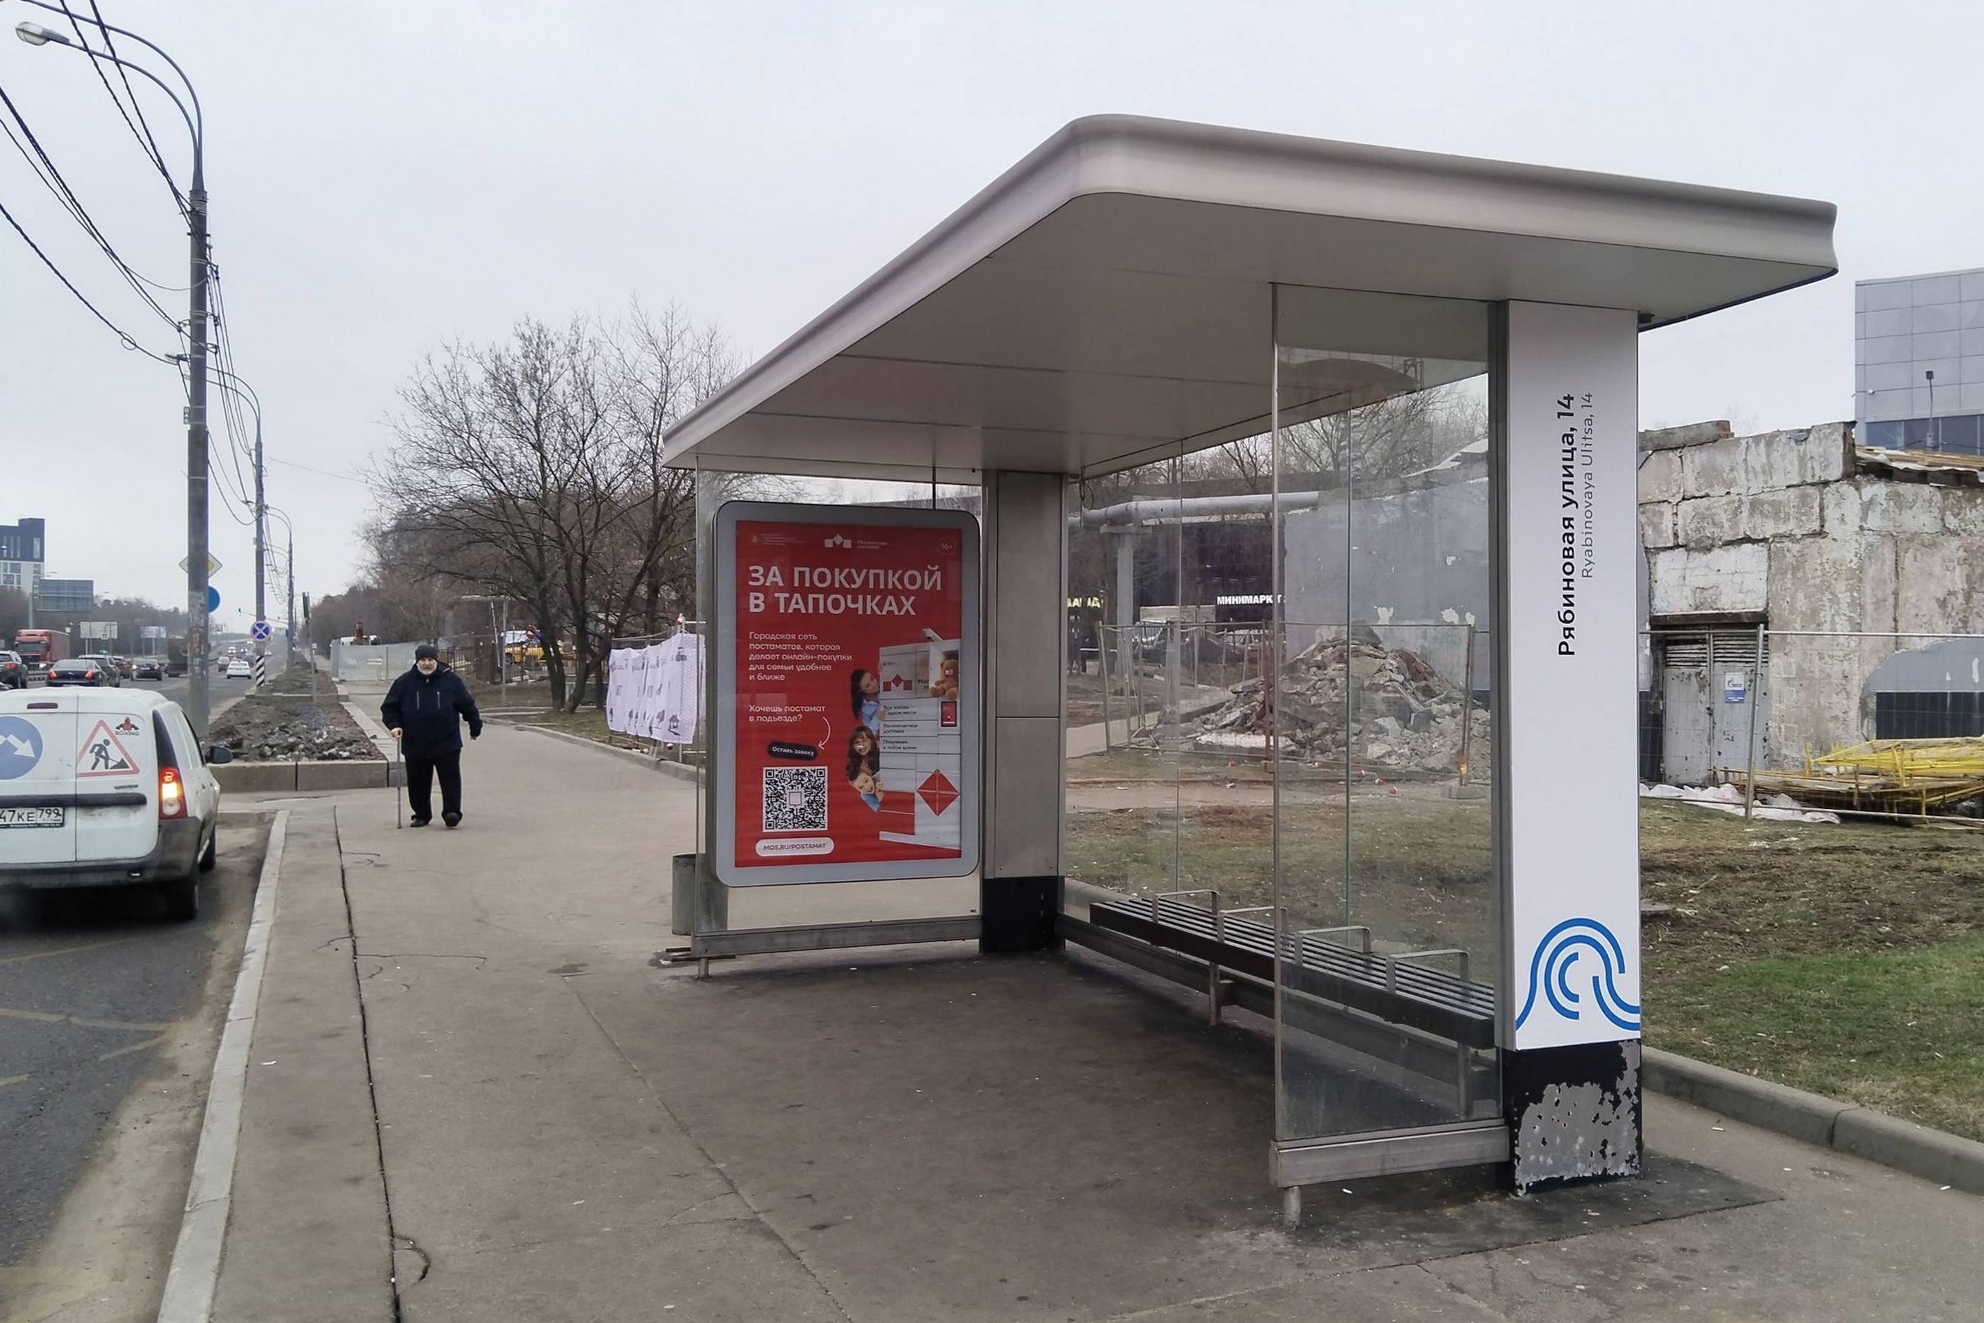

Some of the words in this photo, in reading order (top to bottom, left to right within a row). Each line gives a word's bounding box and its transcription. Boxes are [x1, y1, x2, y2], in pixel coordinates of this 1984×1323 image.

[1581, 393, 1593, 409] 14
[1557, 394, 1575, 419] 14
[1581, 414, 1594, 466] Ulitsa,
[1562, 427, 1579, 509] улица,
[1581, 472, 1595, 578] Ryabinovaya
[748, 565, 784, 587] ЗА
[793, 564, 942, 591] ПОКУПКОЙ
[1557, 517, 1575, 655] Рябиновая
[749, 592, 766, 613] В
[774, 592, 916, 616] ТАПОЧКАХ
[749, 632, 796, 641] Городская
[797, 633, 818, 641] сеть
[805, 644, 841, 652] которая
[748, 653, 780, 661] делает
[781, 652, 853, 662] онлайн-покупки
[795, 662, 832, 672] удобнее
[757, 672, 786, 681] ближе
[749, 704, 783, 713] Хочешь
[784, 705, 826, 713] постамат
[756, 713, 803, 723] подъезде?
[772, 746, 794, 754] Оставь
[38, 808, 60, 819] 799
[763, 843, 827, 851] MOS.RU/POSTAMAT
